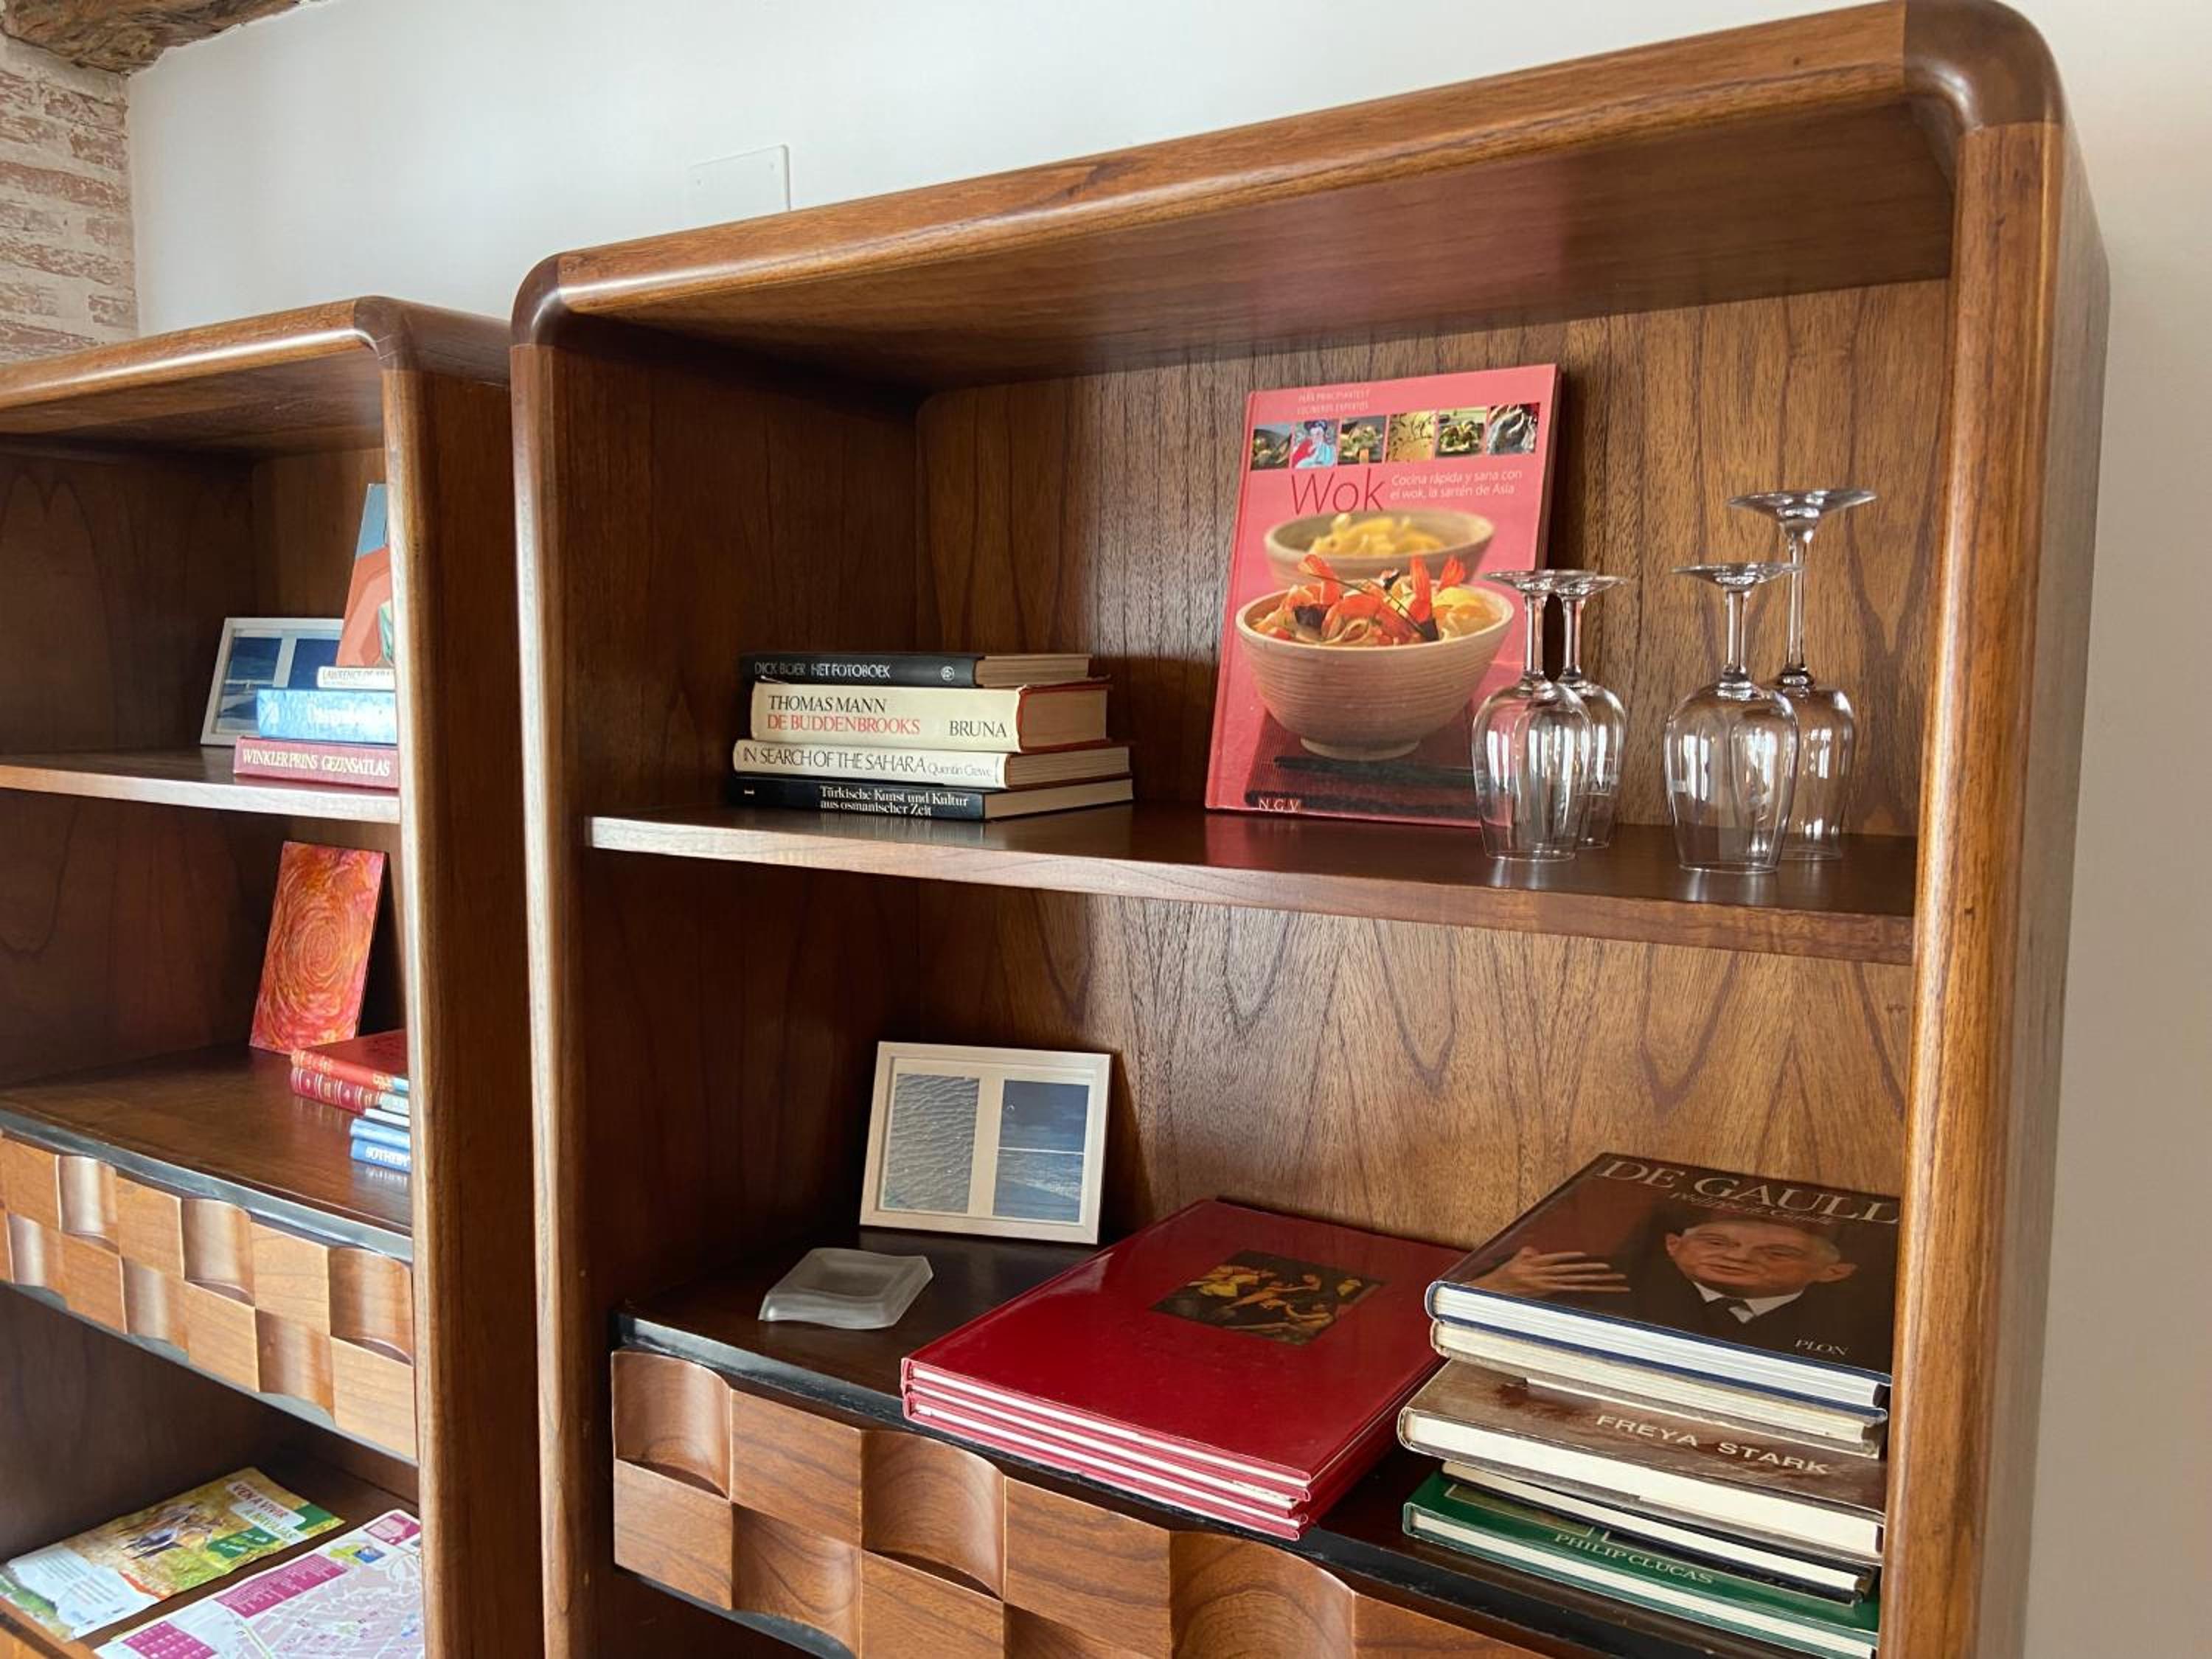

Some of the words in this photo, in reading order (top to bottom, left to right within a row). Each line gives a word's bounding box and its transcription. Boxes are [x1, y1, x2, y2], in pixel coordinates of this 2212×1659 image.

[1391, 474, 1426, 486] Cocina
[1430, 472, 1462, 486] rápida
[1464, 473, 1473, 485] y
[1474, 472, 1498, 482] sana
[1501, 470, 1522, 481] con
[1292, 468, 1385, 515] Wok
[1390, 488, 1399, 499] el
[1428, 487, 1438, 497] la
[1440, 485, 1472, 498] sartén
[1475, 484, 1490, 495] de
[1492, 483, 1514, 495] Asia
[754, 662, 776, 675] DICK
[780, 664, 805, 676] BOER
[811, 664, 831, 677] HET
[831, 664, 890, 678] FOTOBOEK
[768, 695, 832, 712] THOMAS
[835, 697, 887, 714] MANN
[767, 714, 787, 731] DE
[790, 716, 921, 735] BUDDENBROOKS
[949, 720, 1007, 738] BRUNA
[243, 748, 288, 767] WINKLER
[288, 753, 317, 769] PRINS
[321, 757, 390, 777] GEZINSATLAS
[743, 747, 758, 762] IN
[760, 748, 812, 767] SEARCH
[813, 751, 832, 768] OF
[832, 752, 864, 770] THE
[866, 754, 927, 773] SAHARA
[928, 762, 962, 776] Quentin
[819, 785, 872, 799] Türkische
[873, 788, 906, 802] Kunst
[908, 790, 931, 804] und
[931, 792, 968, 807] Kultur
[820, 801, 839, 810] aus
[841, 801, 908, 815] osmanischer
[910, 803, 933, 817] Zeit
[1594, 1160, 1686, 1189] DE
[1694, 1177, 1899, 1225] GAULL
[1795, 1337, 1848, 1356] PLON
[1596, 1413, 1698, 1447] FREYA
[1717, 1441, 1830, 1475] STARK
[1554, 1533, 1628, 1559] PHILIP
[1627, 1554, 1714, 1585] CLUCAS
